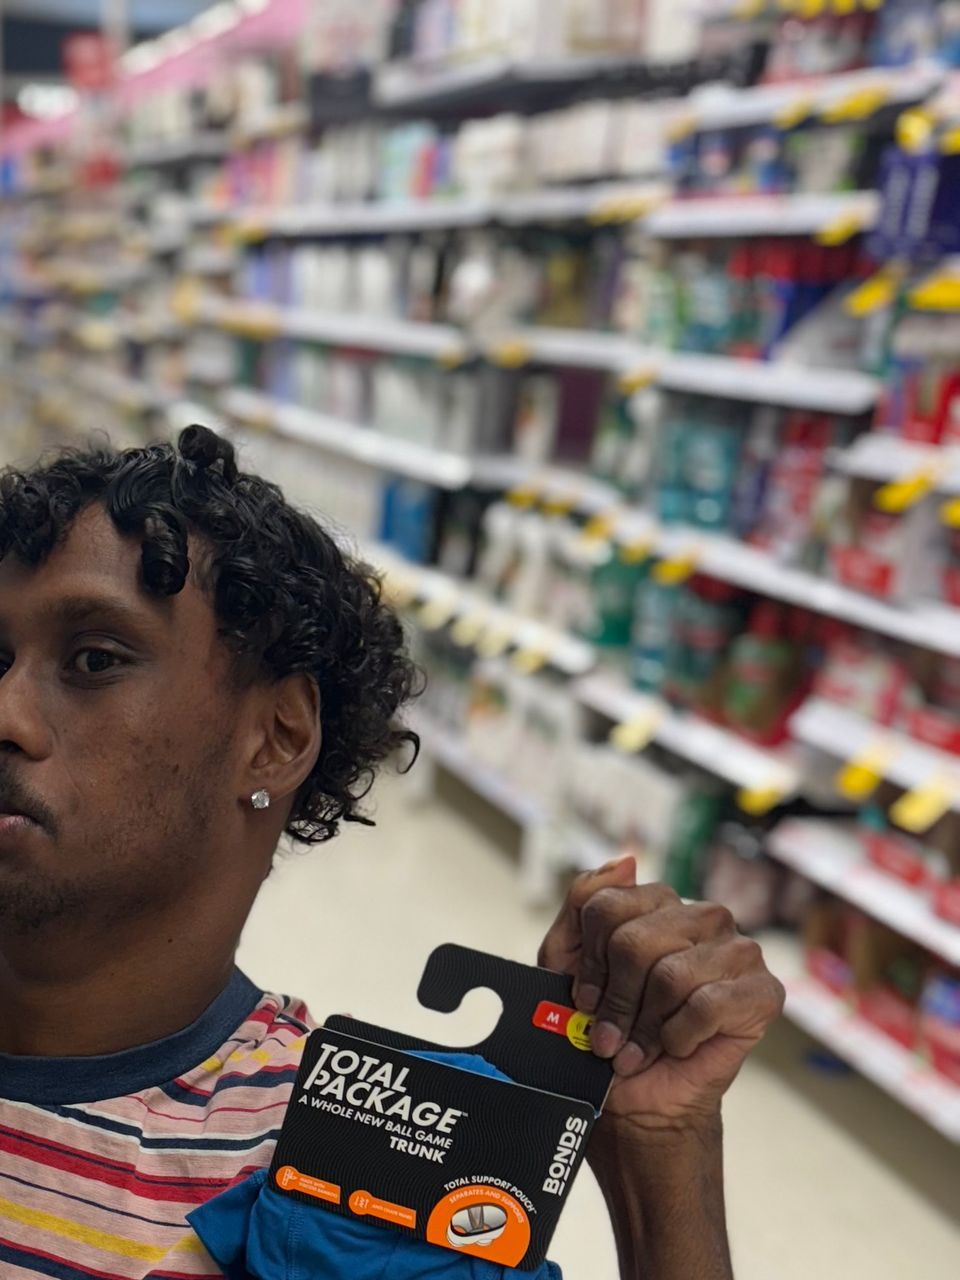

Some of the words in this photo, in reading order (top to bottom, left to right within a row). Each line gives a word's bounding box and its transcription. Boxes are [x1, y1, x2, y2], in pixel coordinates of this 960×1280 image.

[546, 1011, 560, 1025] M
[315, 1043, 410, 1092] TOTAL
[298, 1094, 308, 1105] A
[311, 1097, 354, 1119] WHOLE
[354, 1111, 385, 1128] NEW
[385, 1121, 412, 1138] BALL
[415, 1130, 454, 1149] GAME
[303, 1069, 462, 1134] PACKAGE
[390, 1136, 447, 1164] TRUNK
[542, 1116, 586, 1196] BONDS
[443, 1177, 470, 1192] TOTAL
[471, 1175, 513, 1190] SUPPORT
[510, 1186, 535, 1213] POUCH
[449, 1189, 484, 1203] SEPARATES
[485, 1190, 501, 1199] AND
